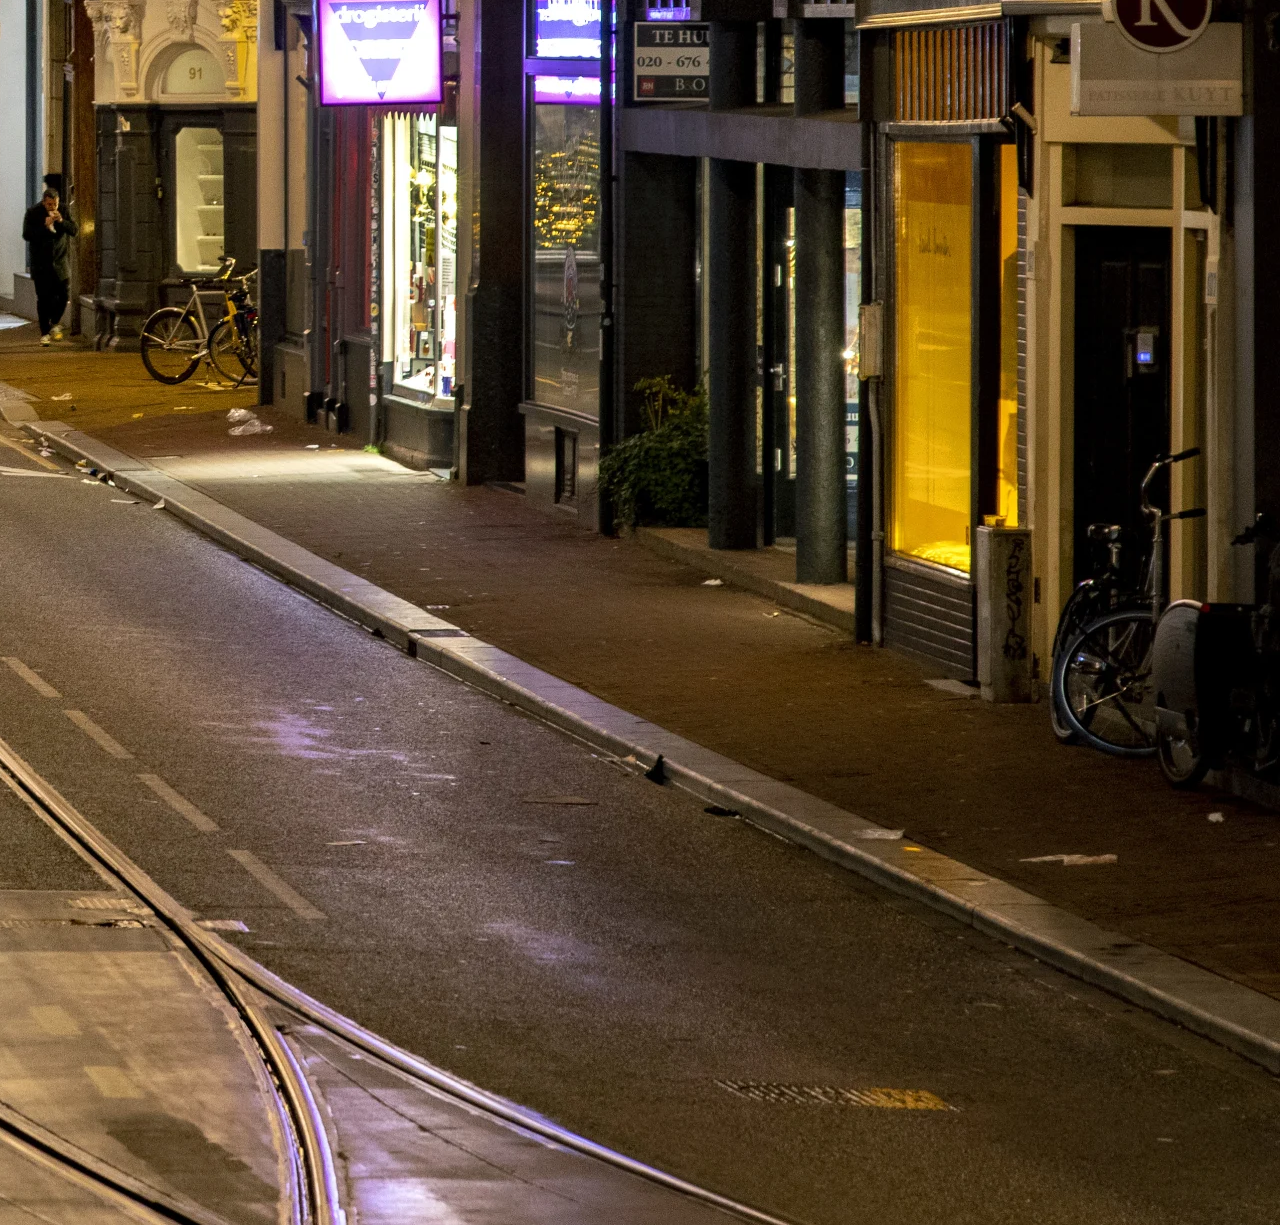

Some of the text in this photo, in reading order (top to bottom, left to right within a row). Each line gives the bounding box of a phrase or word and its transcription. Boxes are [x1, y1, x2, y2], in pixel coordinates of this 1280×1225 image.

[334, 4, 425, 28] drogisterij
[652, 30, 675, 43] TE
[636, 56, 663, 67] 020
[676, 55, 701, 69] 676
[189, 67, 202, 80] 91
[1173, 86, 1233, 102] KUYT
